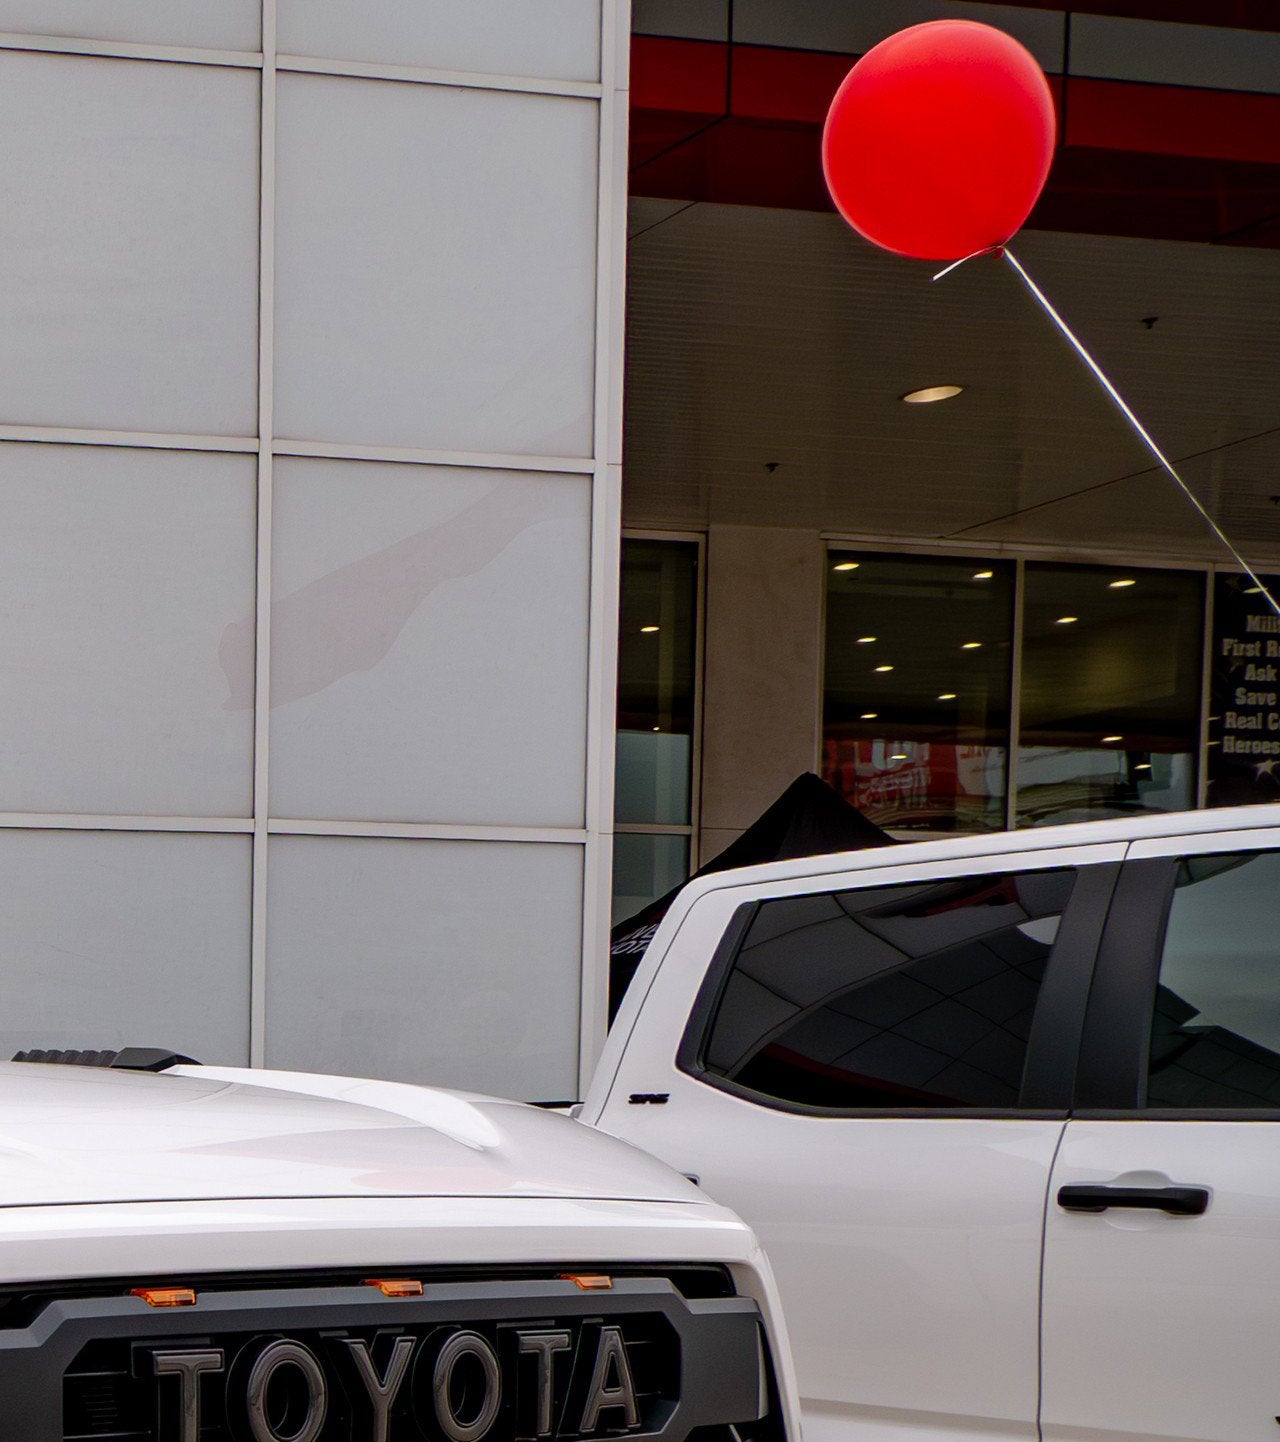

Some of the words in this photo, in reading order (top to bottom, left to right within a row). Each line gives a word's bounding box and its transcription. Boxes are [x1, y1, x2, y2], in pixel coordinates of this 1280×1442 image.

[1222, 638, 1262, 657] First
[1244, 663, 1278, 682] Ask
[1235, 687, 1278, 706] Save
[1224, 711, 1263, 730] Real
